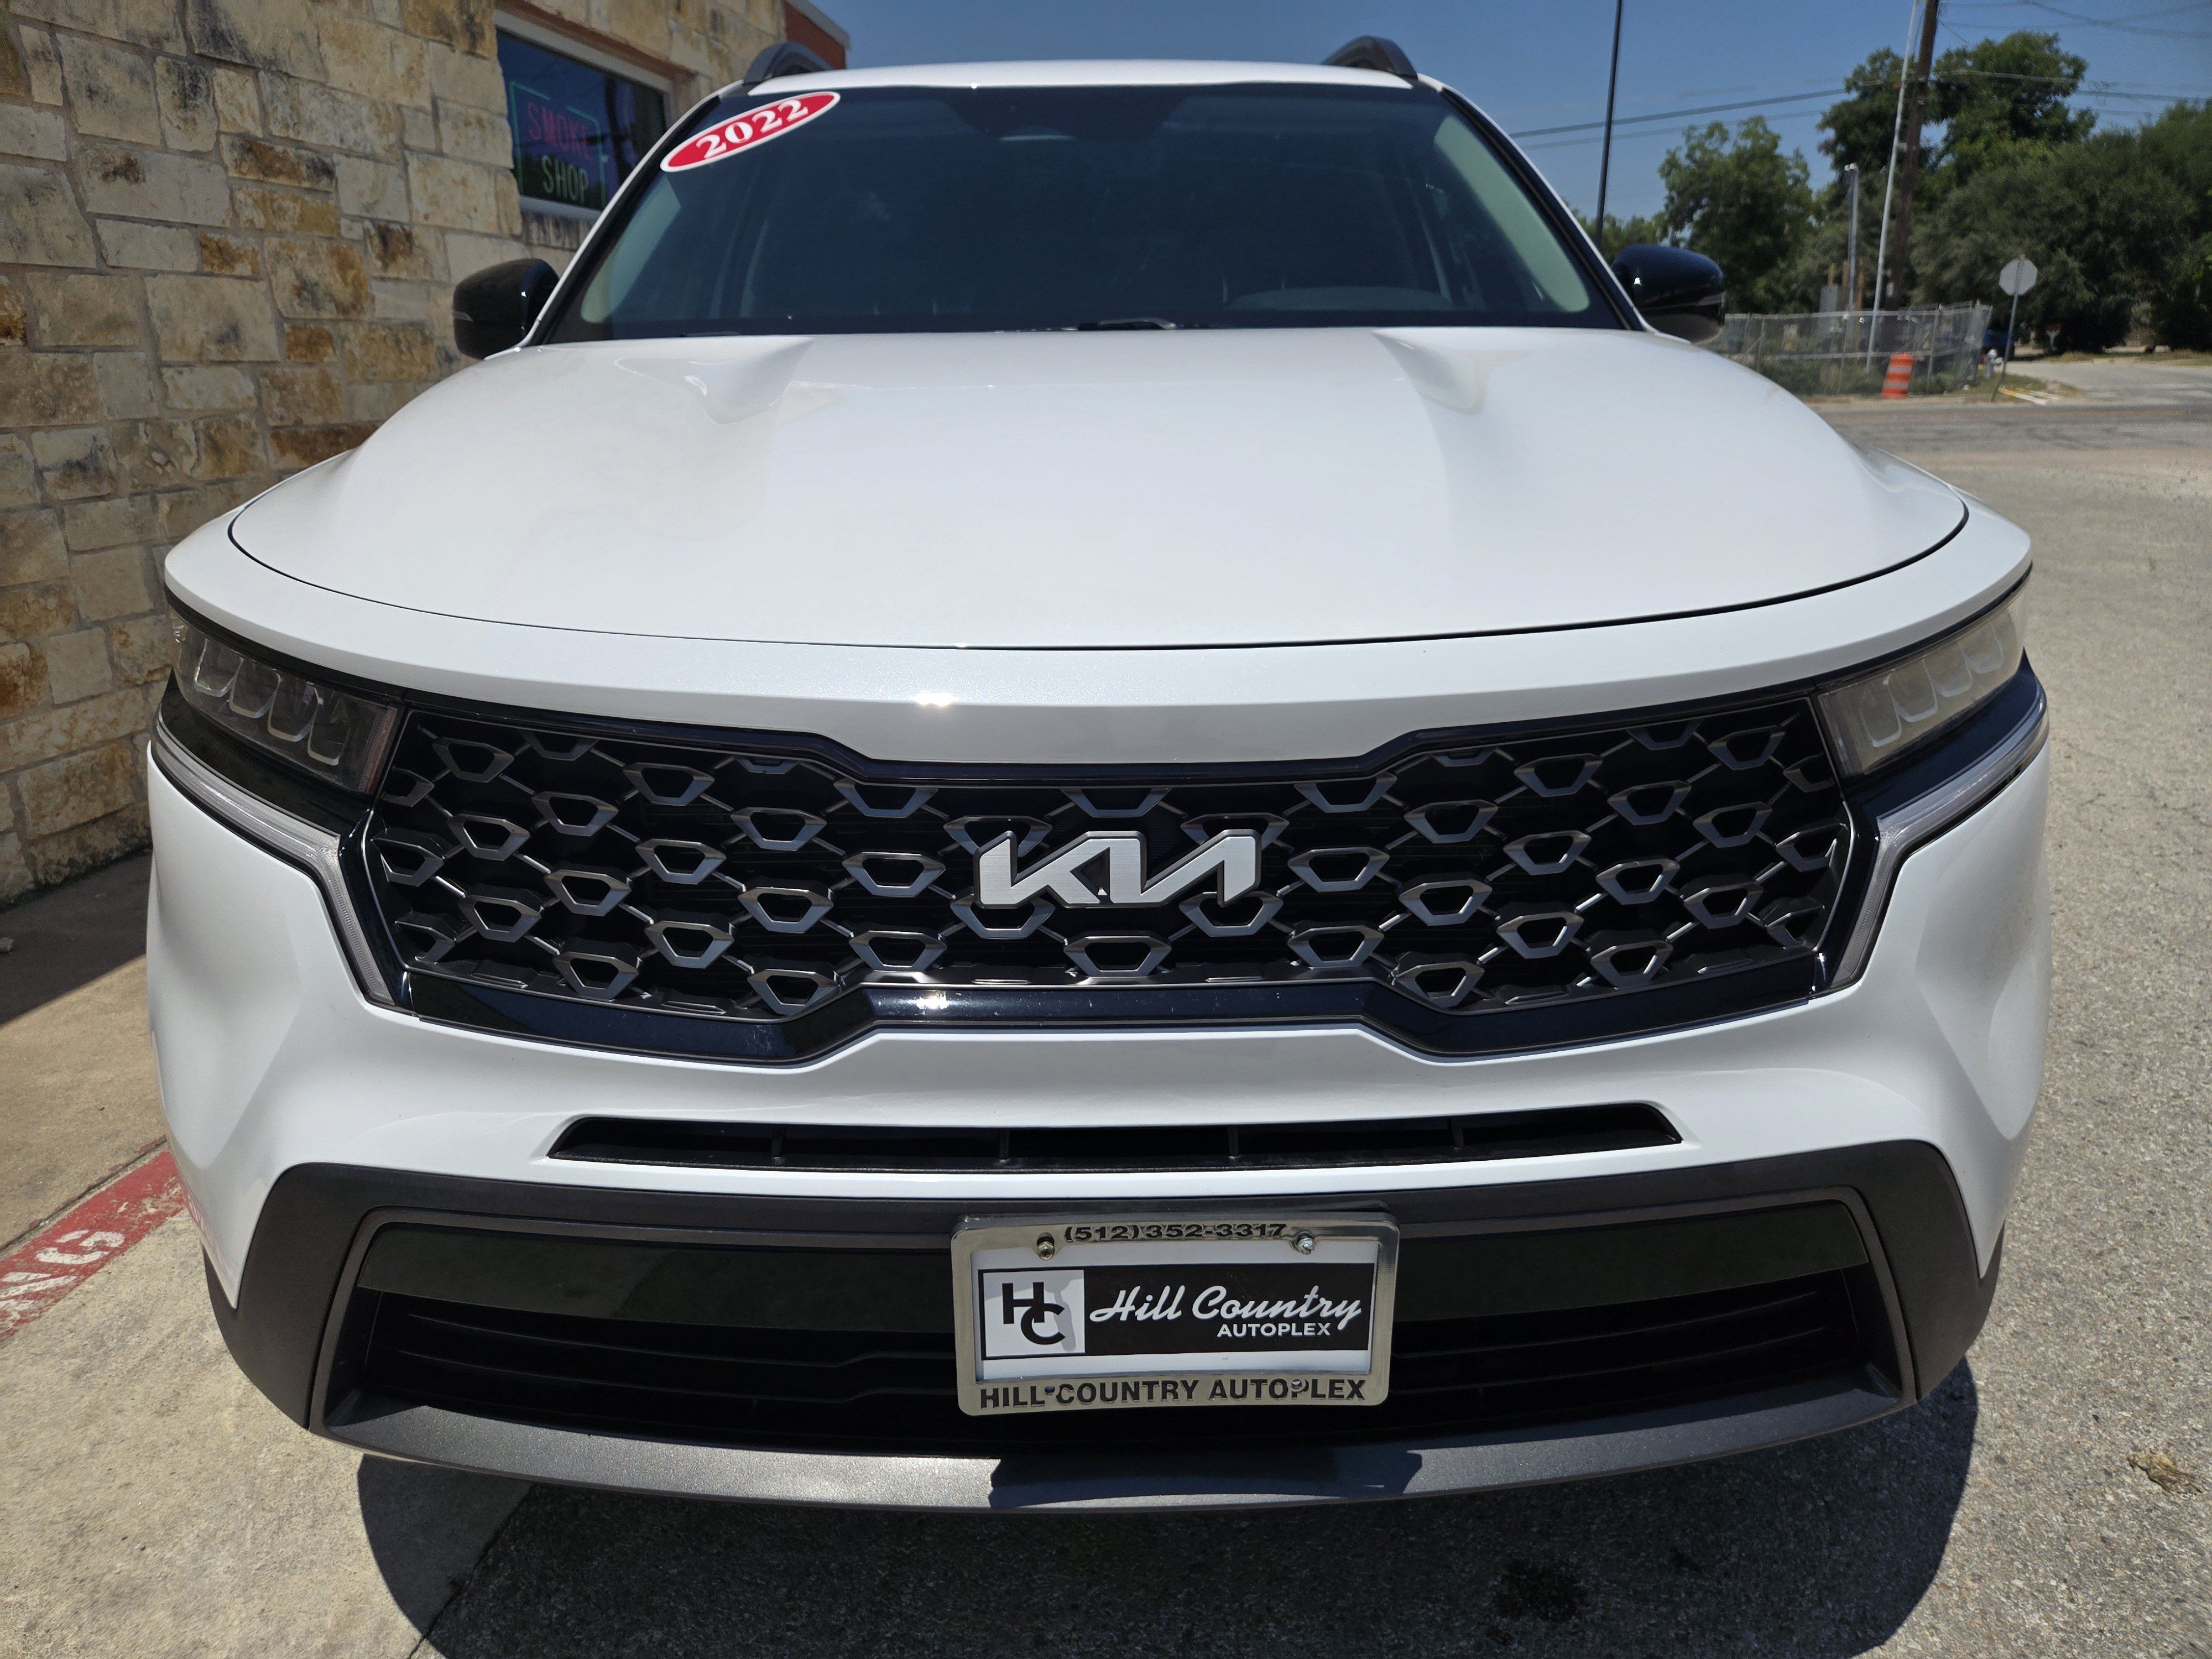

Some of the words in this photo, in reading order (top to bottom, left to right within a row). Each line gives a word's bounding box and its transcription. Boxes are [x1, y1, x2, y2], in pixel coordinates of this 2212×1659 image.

[528, 102, 592, 160] SMOKE
[696, 99, 808, 159] 2022
[541, 154, 589, 204] SHOP
[974, 830, 1261, 909] KIA
[1064, 1223, 1287, 1242] (512)352-3317
[1001, 1281, 1066, 1345] HC
[1089, 1285, 1186, 1322] Hill
[1192, 1285, 1362, 1331] Country
[1217, 1322, 1332, 1338] AUTOPLEX
[980, 1385, 1045, 1409] HILL
[1056, 1379, 1200, 1406] COUNTRY
[1208, 1378, 1366, 1401] AUTOPLEX
